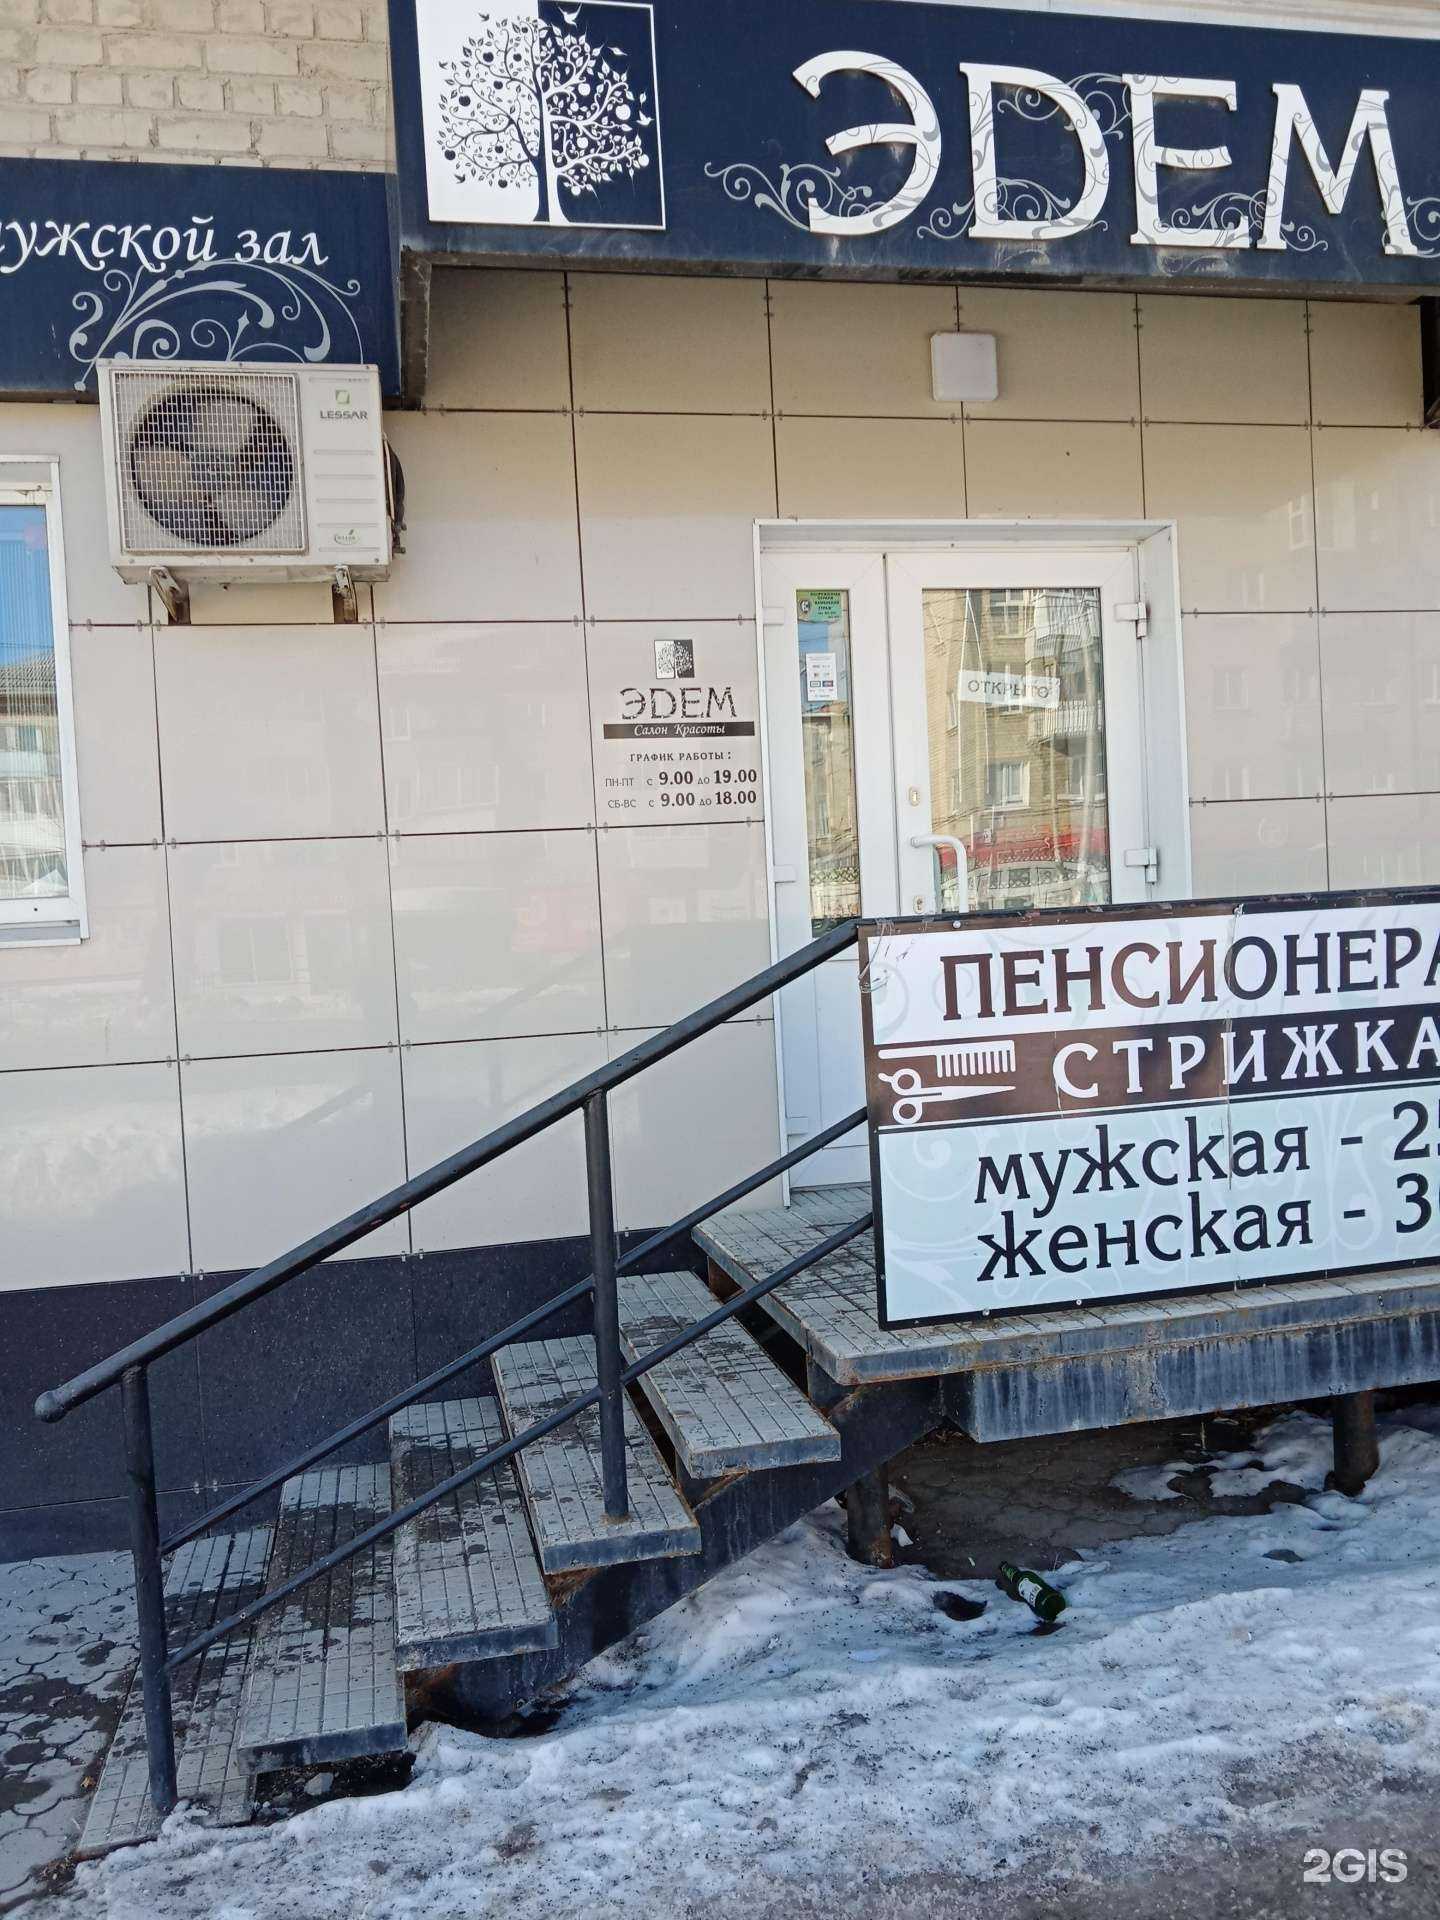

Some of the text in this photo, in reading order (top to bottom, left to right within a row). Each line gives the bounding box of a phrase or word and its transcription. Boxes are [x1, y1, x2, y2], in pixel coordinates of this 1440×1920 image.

[0, 215, 329, 273] ужской зал
[320, 410, 368, 420] LESSAR
[634, 723, 727, 738] Салон Красоты
[630, 753, 674, 762] ГРАФИК
[605, 777, 634, 787] ПН-ПТ
[659, 770, 693, 786] 9.00
[714, 769, 757, 784] 19.00
[608, 799, 637, 808] СБ-ВС
[660, 792, 695, 807] 9.00
[715, 790, 757, 805] 18.00
[974, 1116, 1310, 1219] мужская
[1394, 1098, 1440, 1160] 2
[976, 1192, 1312, 1282] женская
[1396, 1173, 1440, 1233] 3
